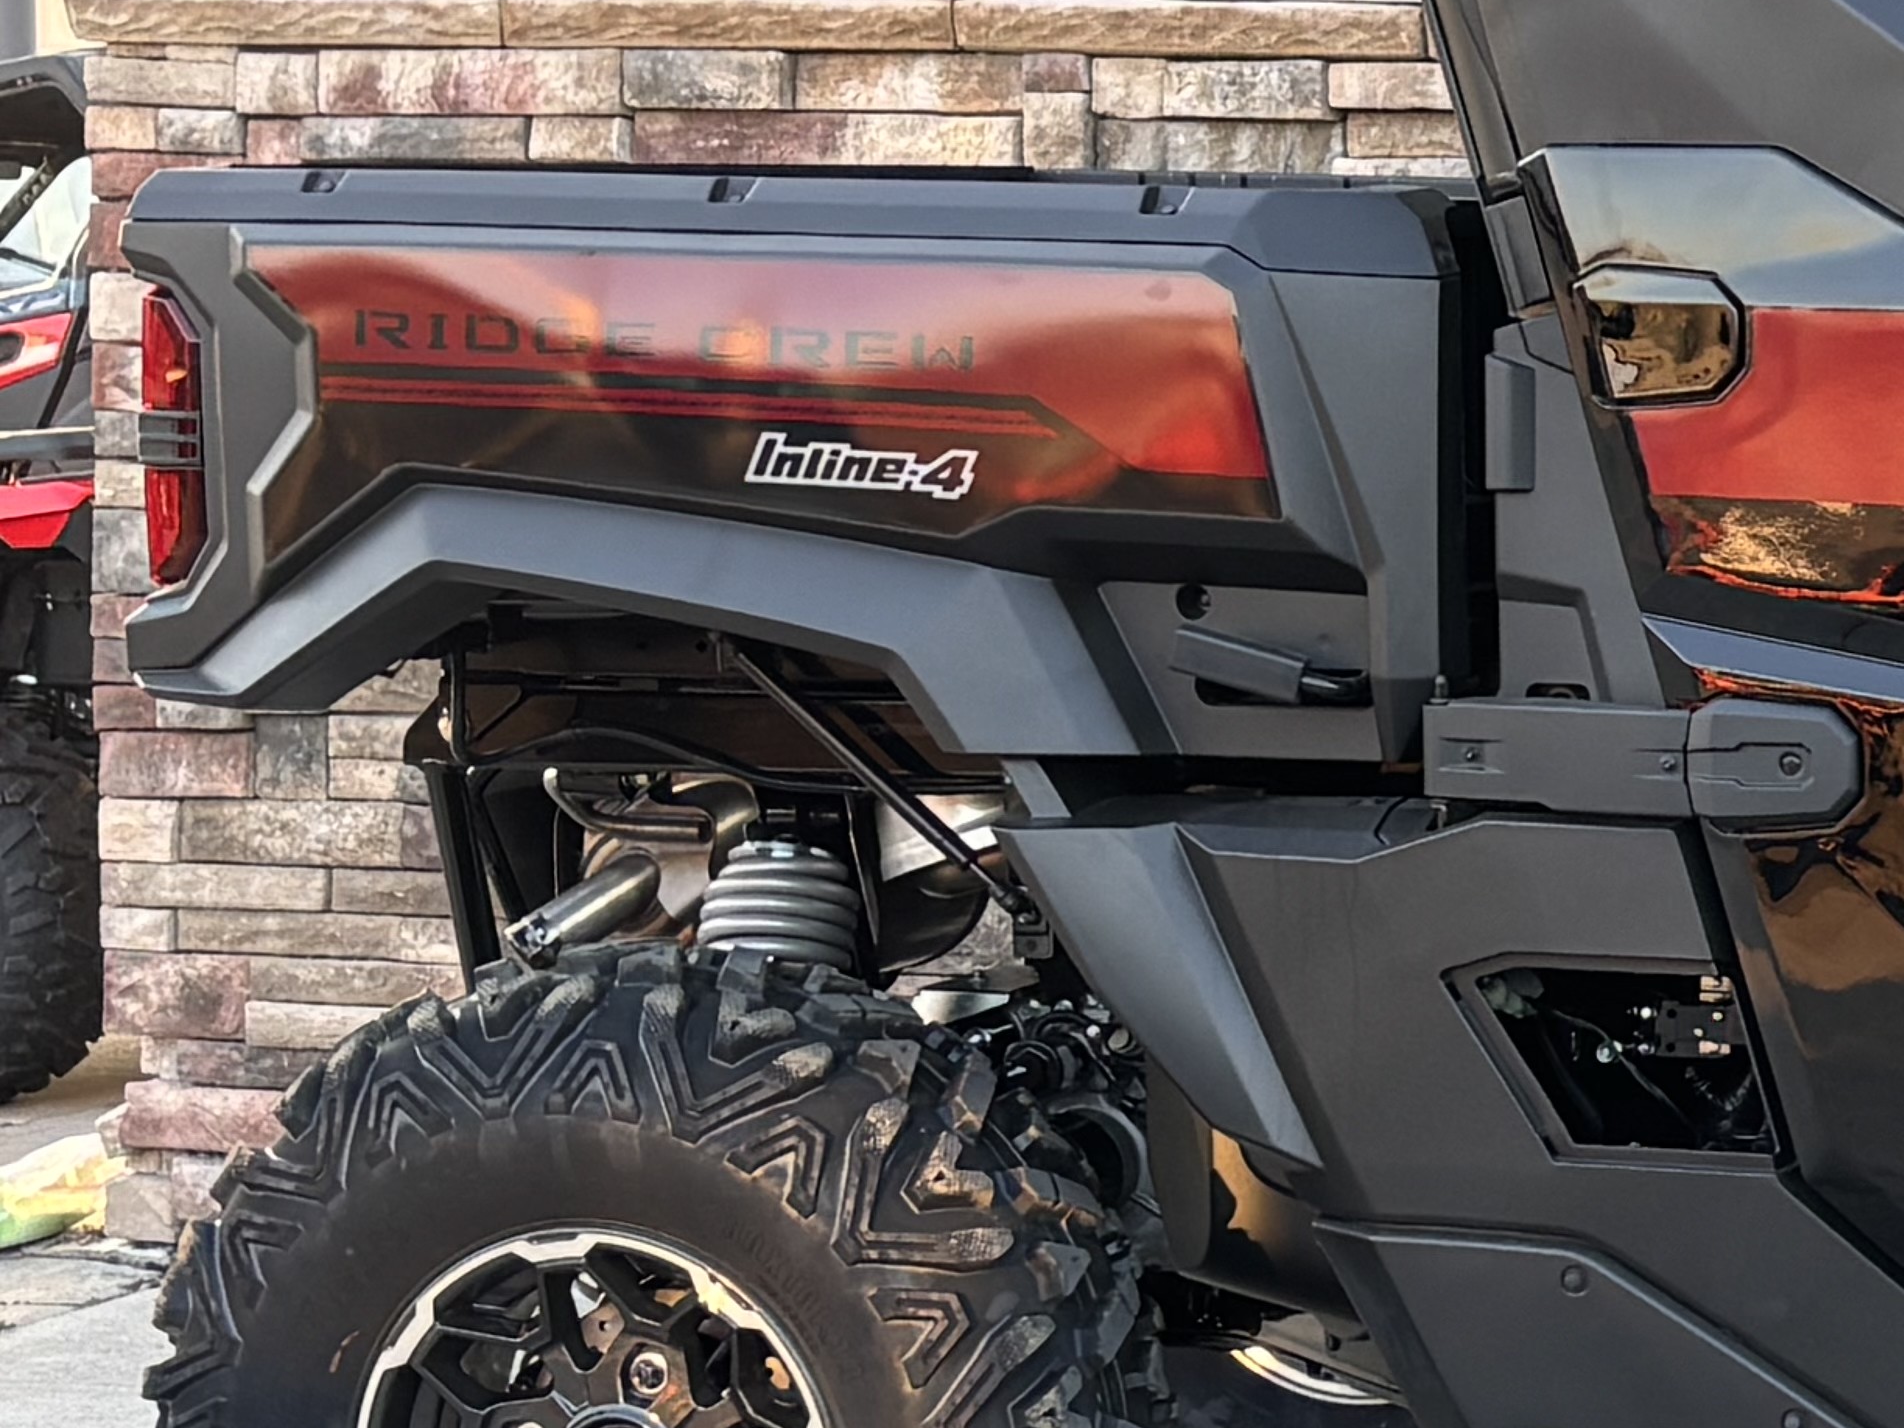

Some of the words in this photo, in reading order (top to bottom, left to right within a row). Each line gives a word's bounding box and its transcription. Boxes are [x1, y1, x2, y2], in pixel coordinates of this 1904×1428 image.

[355, 309, 656, 357] RIDGE
[701, 326, 974, 372] CREW
[747, 432, 977, 498] Inline-4
